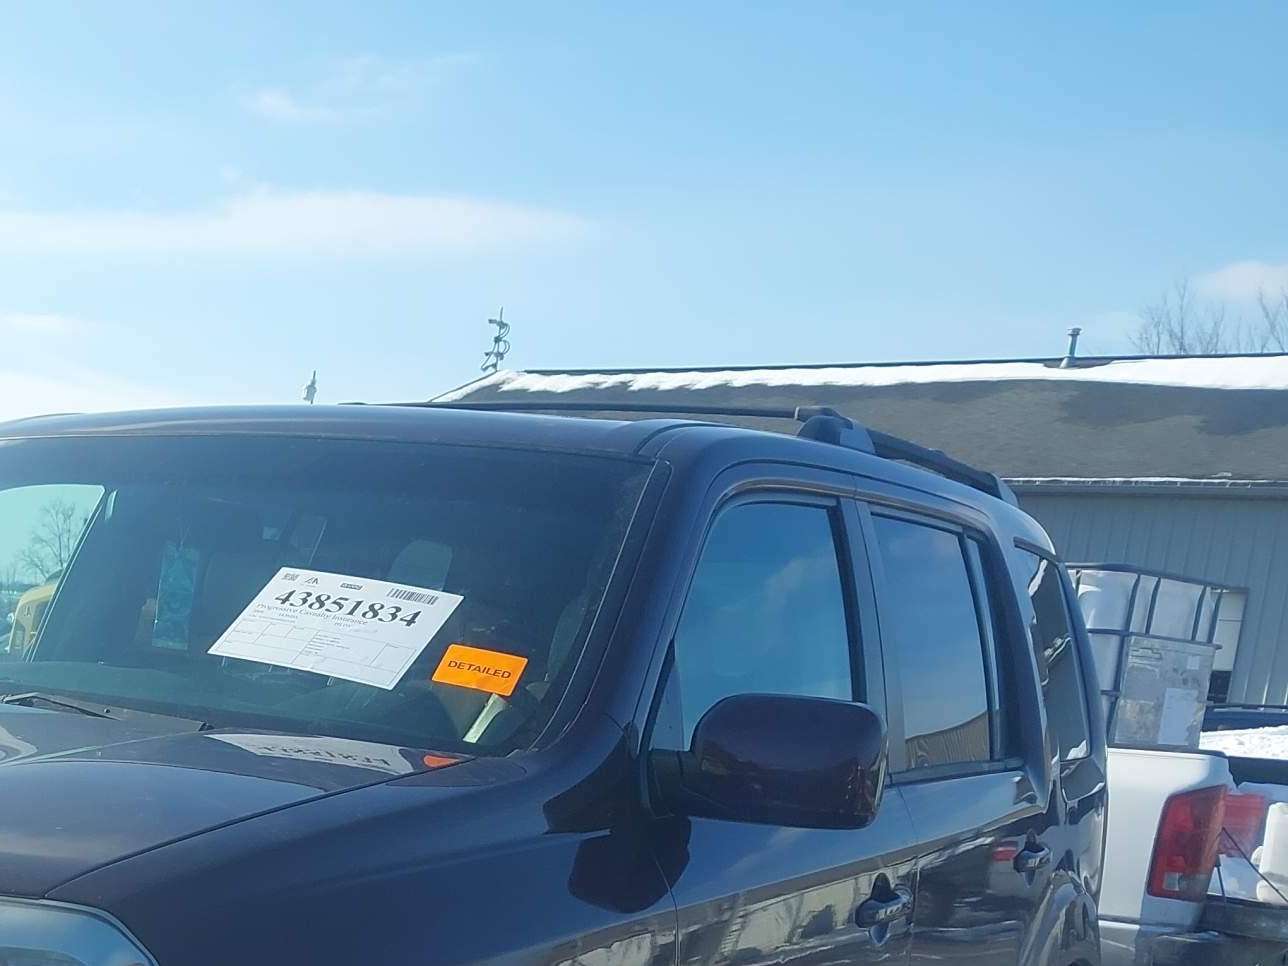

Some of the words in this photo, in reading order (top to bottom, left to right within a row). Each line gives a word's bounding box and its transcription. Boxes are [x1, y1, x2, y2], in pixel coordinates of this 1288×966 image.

[256, 602, 299, 615] Progressive
[332, 614, 368, 626] Insurance
[274, 589, 421, 627] 43851834
[447, 660, 512, 679] DETAILED
